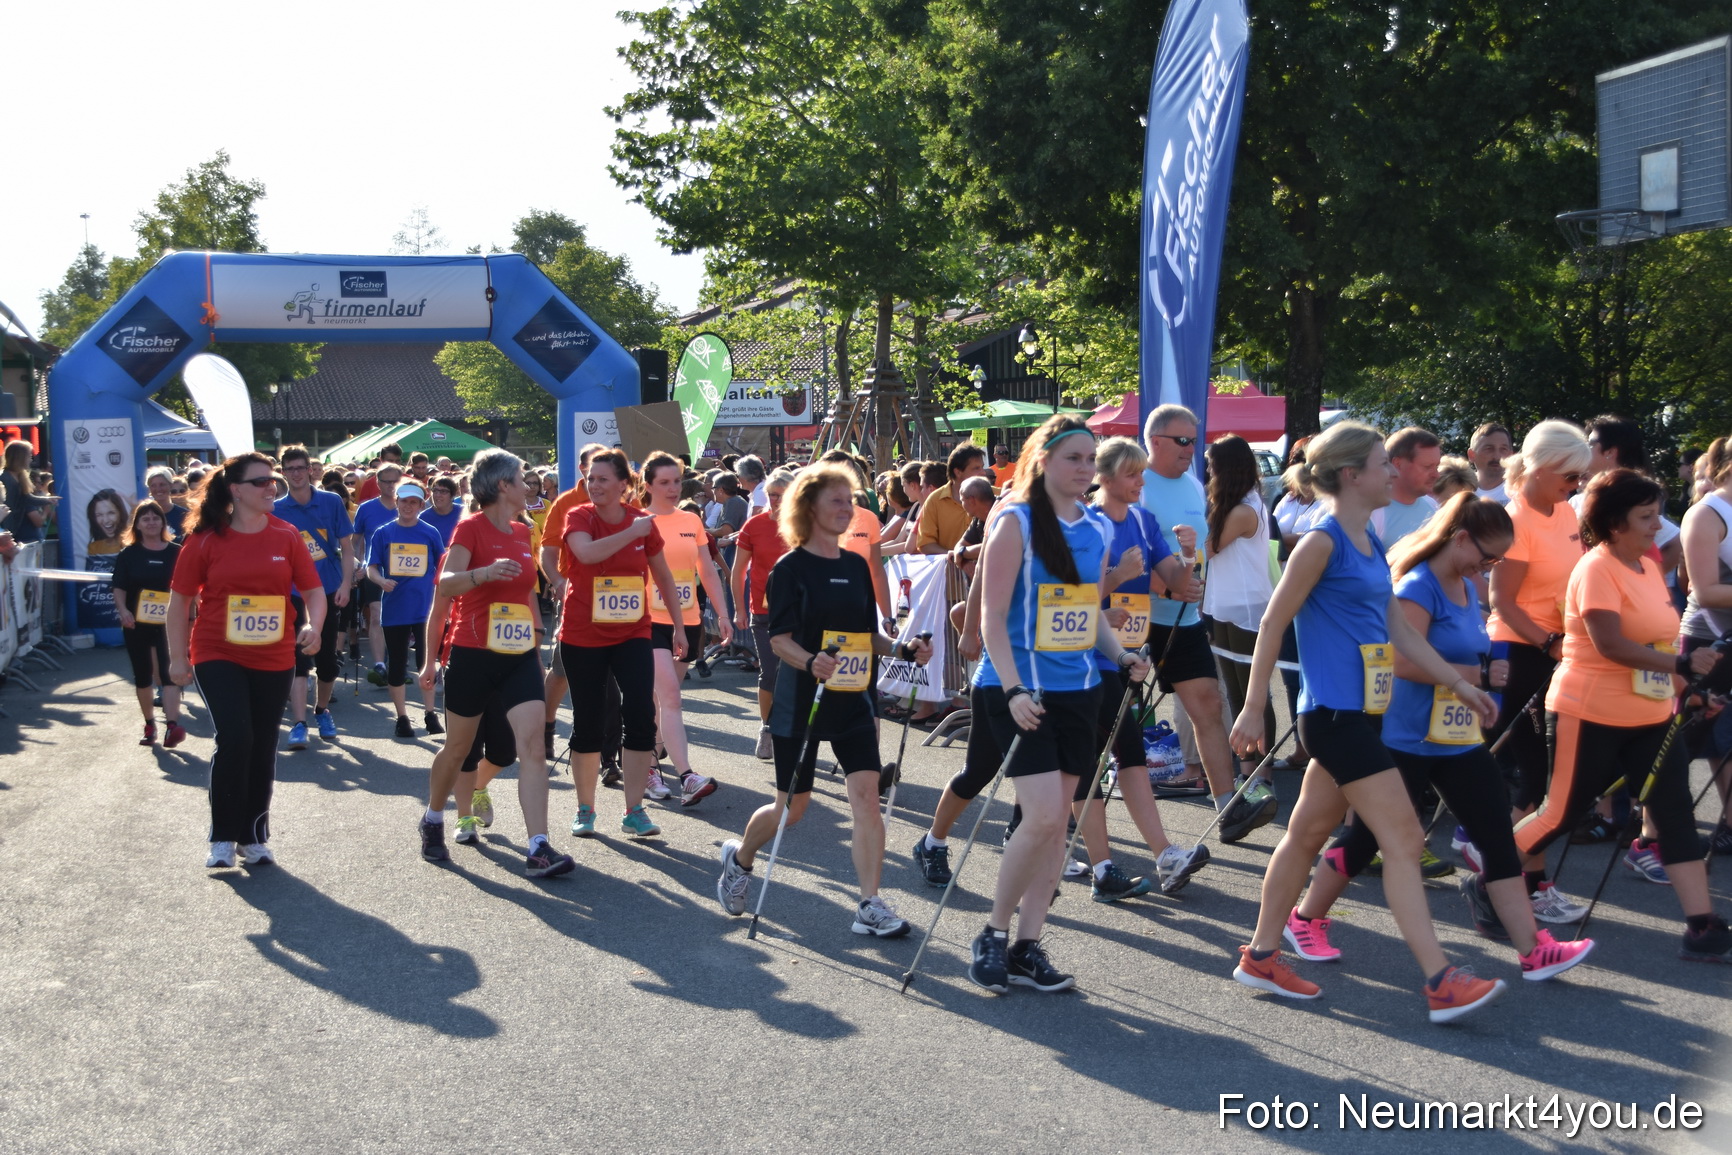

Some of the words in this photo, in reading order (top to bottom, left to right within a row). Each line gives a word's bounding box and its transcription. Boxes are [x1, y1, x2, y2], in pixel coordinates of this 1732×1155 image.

[1164, 13, 1221, 285] Fischer
[1188, 60, 1229, 281] AUTOMOBILE
[324, 298, 427, 317] firmenlauf
[122, 335, 180, 347] Fischer
[698, 379, 723, 412] AOK
[398, 556, 420, 567] 782
[598, 595, 640, 610] 1056
[234, 615, 279, 631] 1055
[1051, 610, 1089, 633] 562
[1118, 615, 1148, 633] 357
[495, 623, 532, 640] 1054
[837, 656, 868, 675] 204
[1442, 705, 1473, 727] 566
